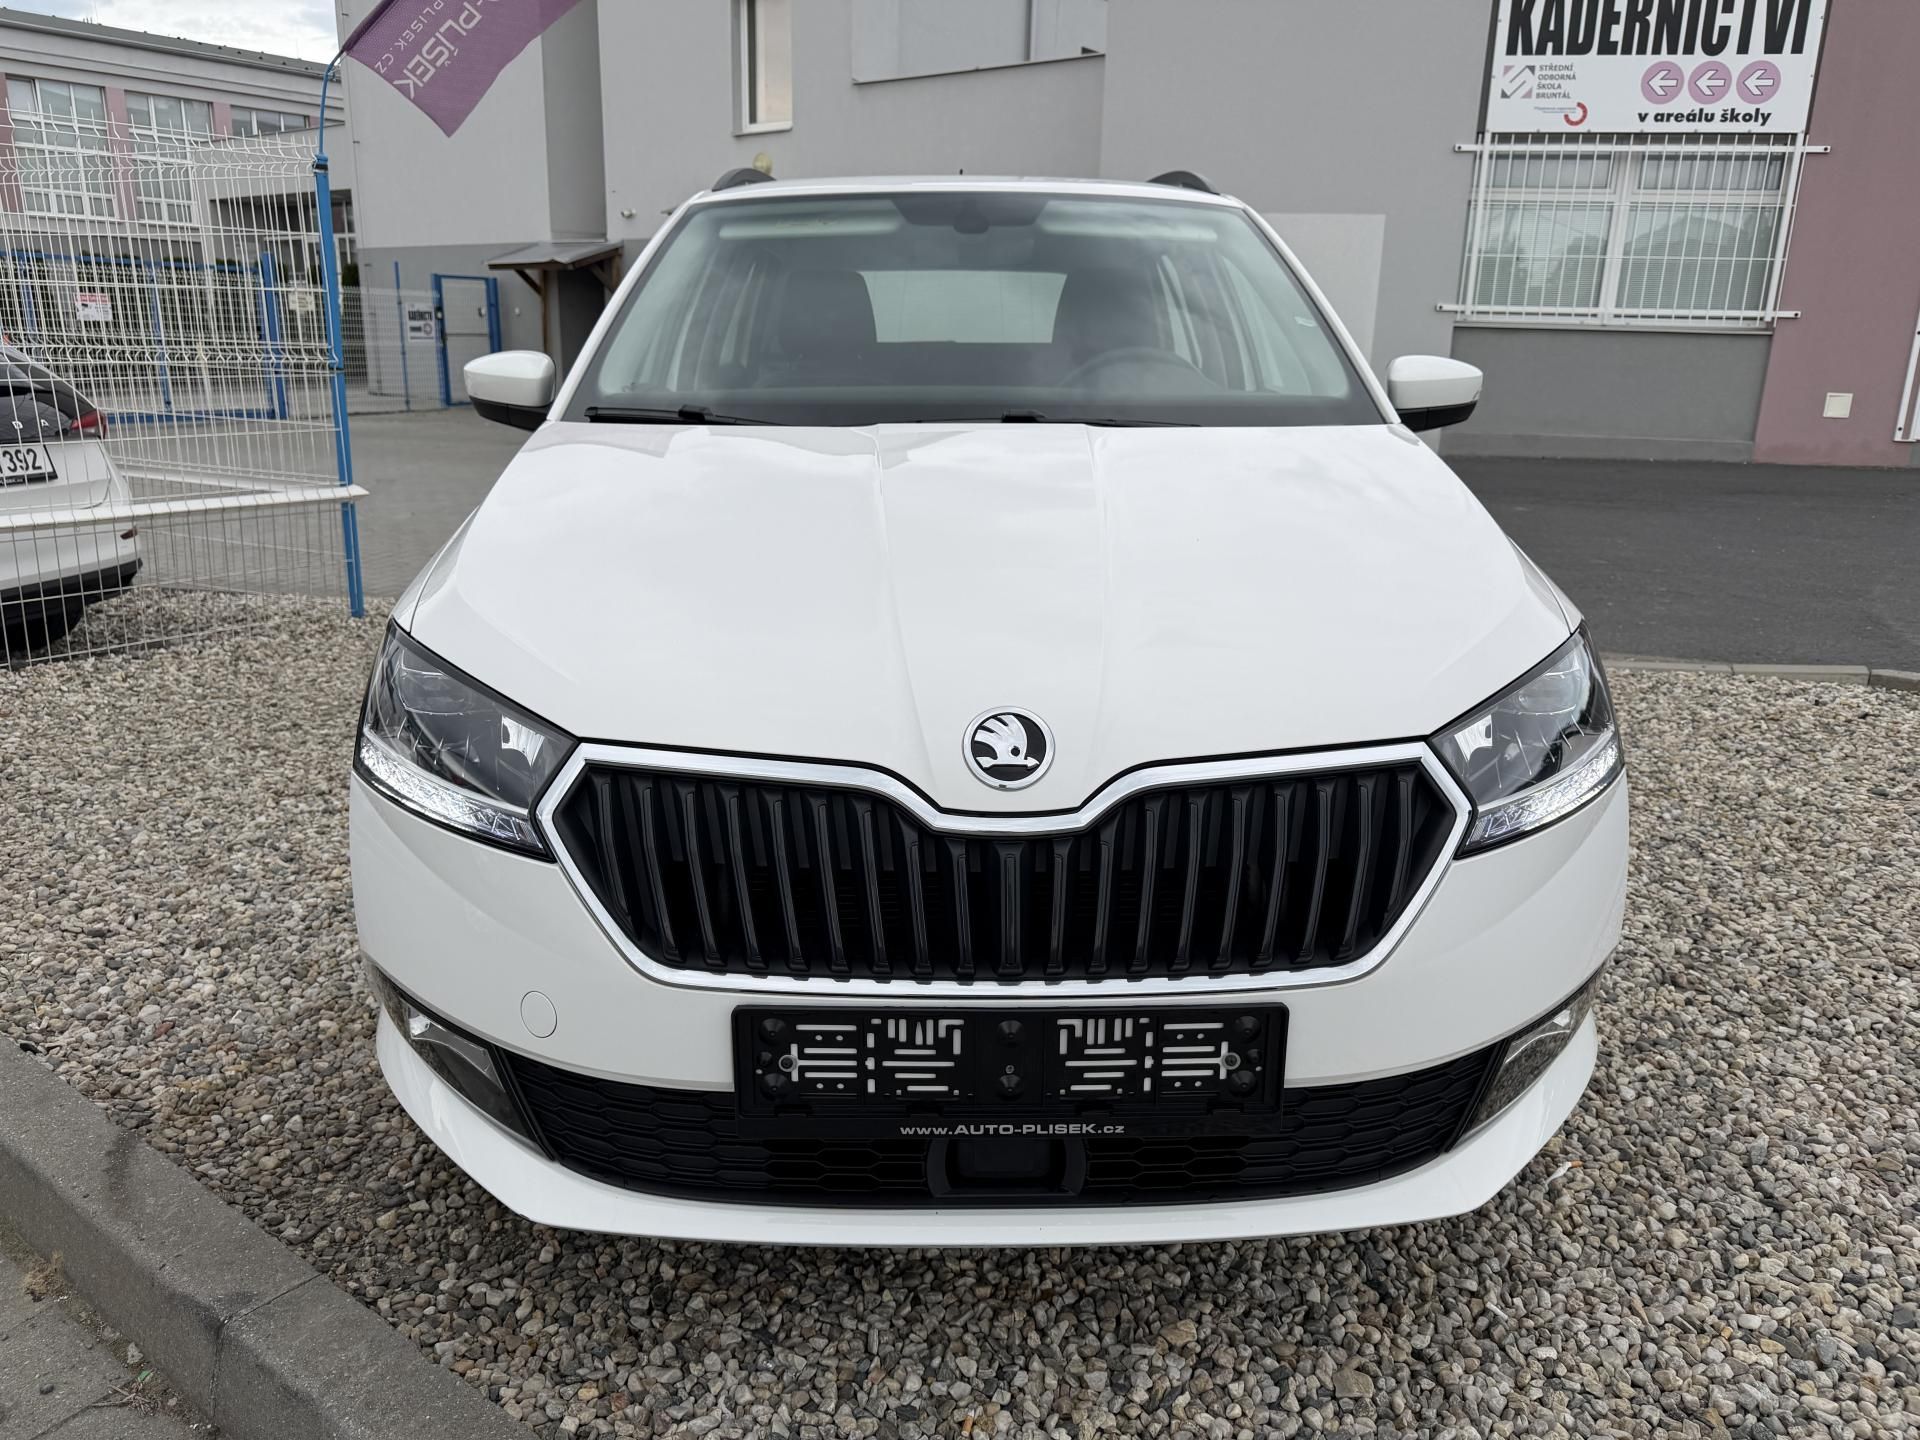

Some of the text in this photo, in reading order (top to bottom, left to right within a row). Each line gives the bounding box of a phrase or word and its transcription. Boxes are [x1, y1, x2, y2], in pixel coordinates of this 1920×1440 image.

[393, 0, 498, 100] -PLÍŠEK
[1538, 63, 1574, 72] STŘEDNÍ
[1537, 72, 1577, 81] ODBORNÁ
[1536, 82, 1562, 90] ŠKOLA
[1535, 91, 1571, 99] BRUNTÁL
[1637, 107, 1773, 127] v areálu školy
[0, 448, 43, 474] 392
[899, 1123, 1126, 1136] www.AUTO-PLISEK.cz
